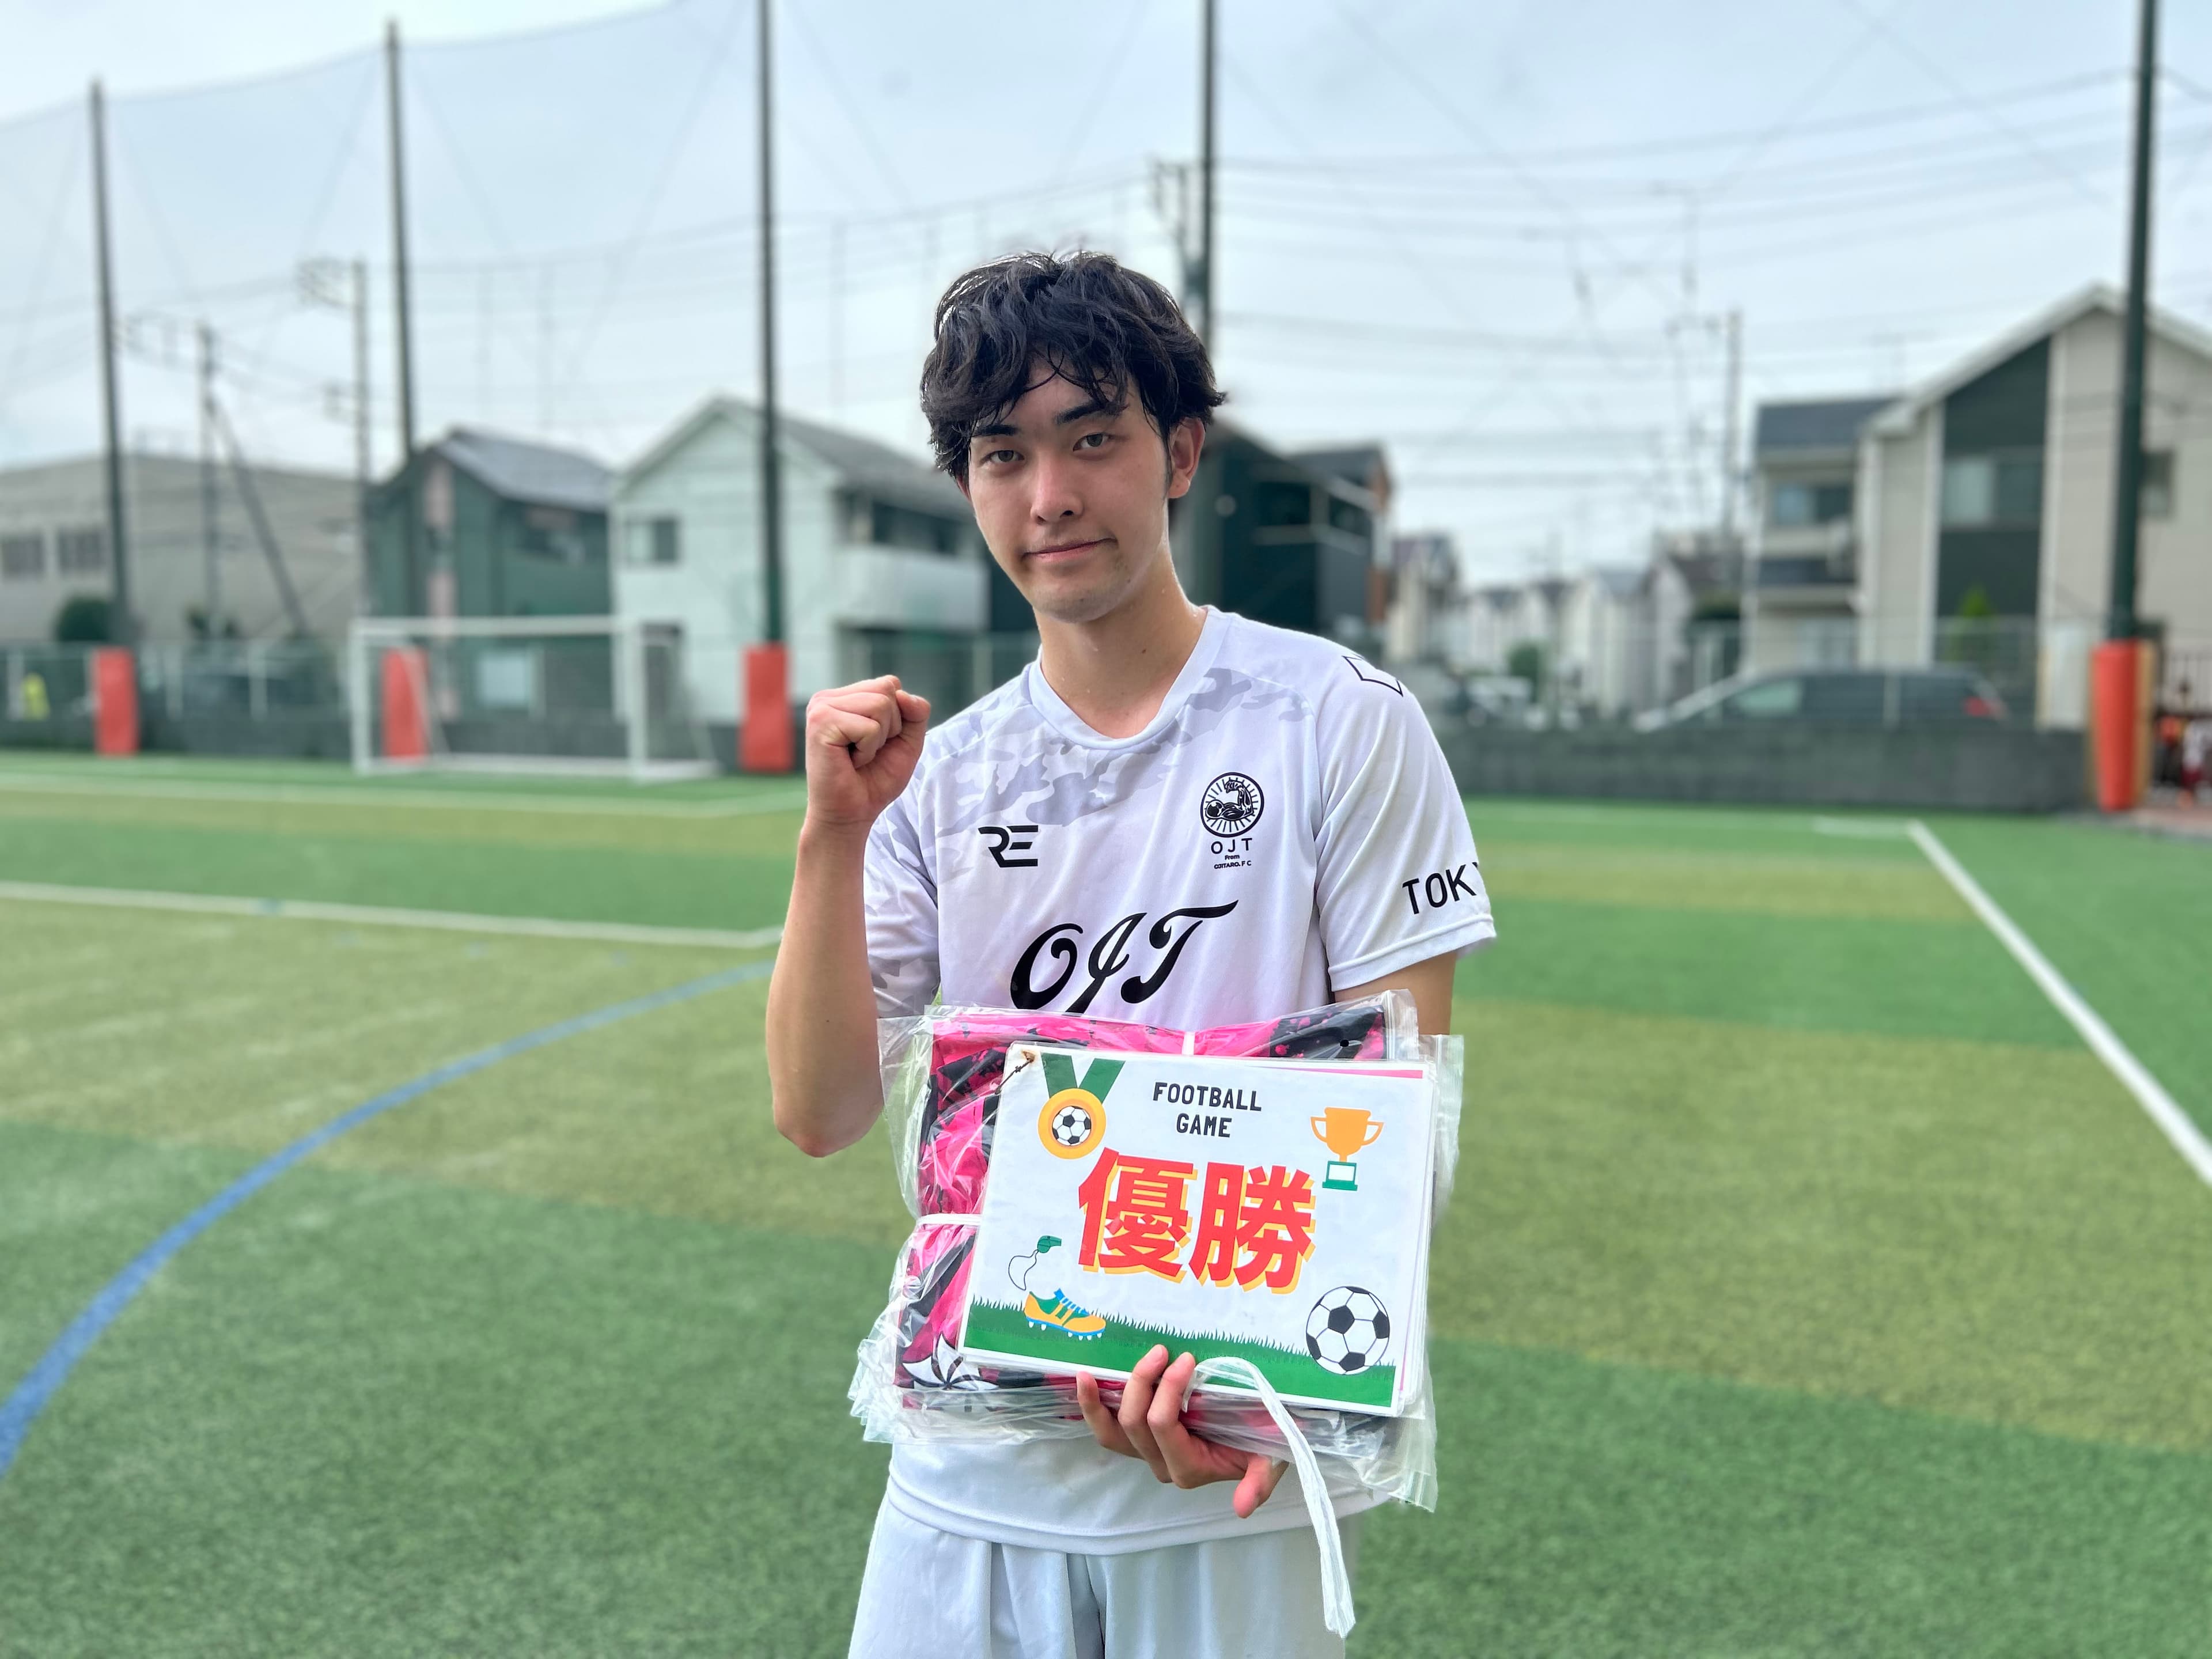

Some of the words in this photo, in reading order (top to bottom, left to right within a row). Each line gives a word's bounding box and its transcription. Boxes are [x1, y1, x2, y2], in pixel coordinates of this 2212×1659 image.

[1210, 838, 1252, 854] OJT
[1402, 862, 1478, 914] TOK
[1153, 1081, 1262, 1112] FOOTBALL
[1176, 1113, 1232, 1138] GAME
[1078, 1146, 1316, 1295] 優勝
